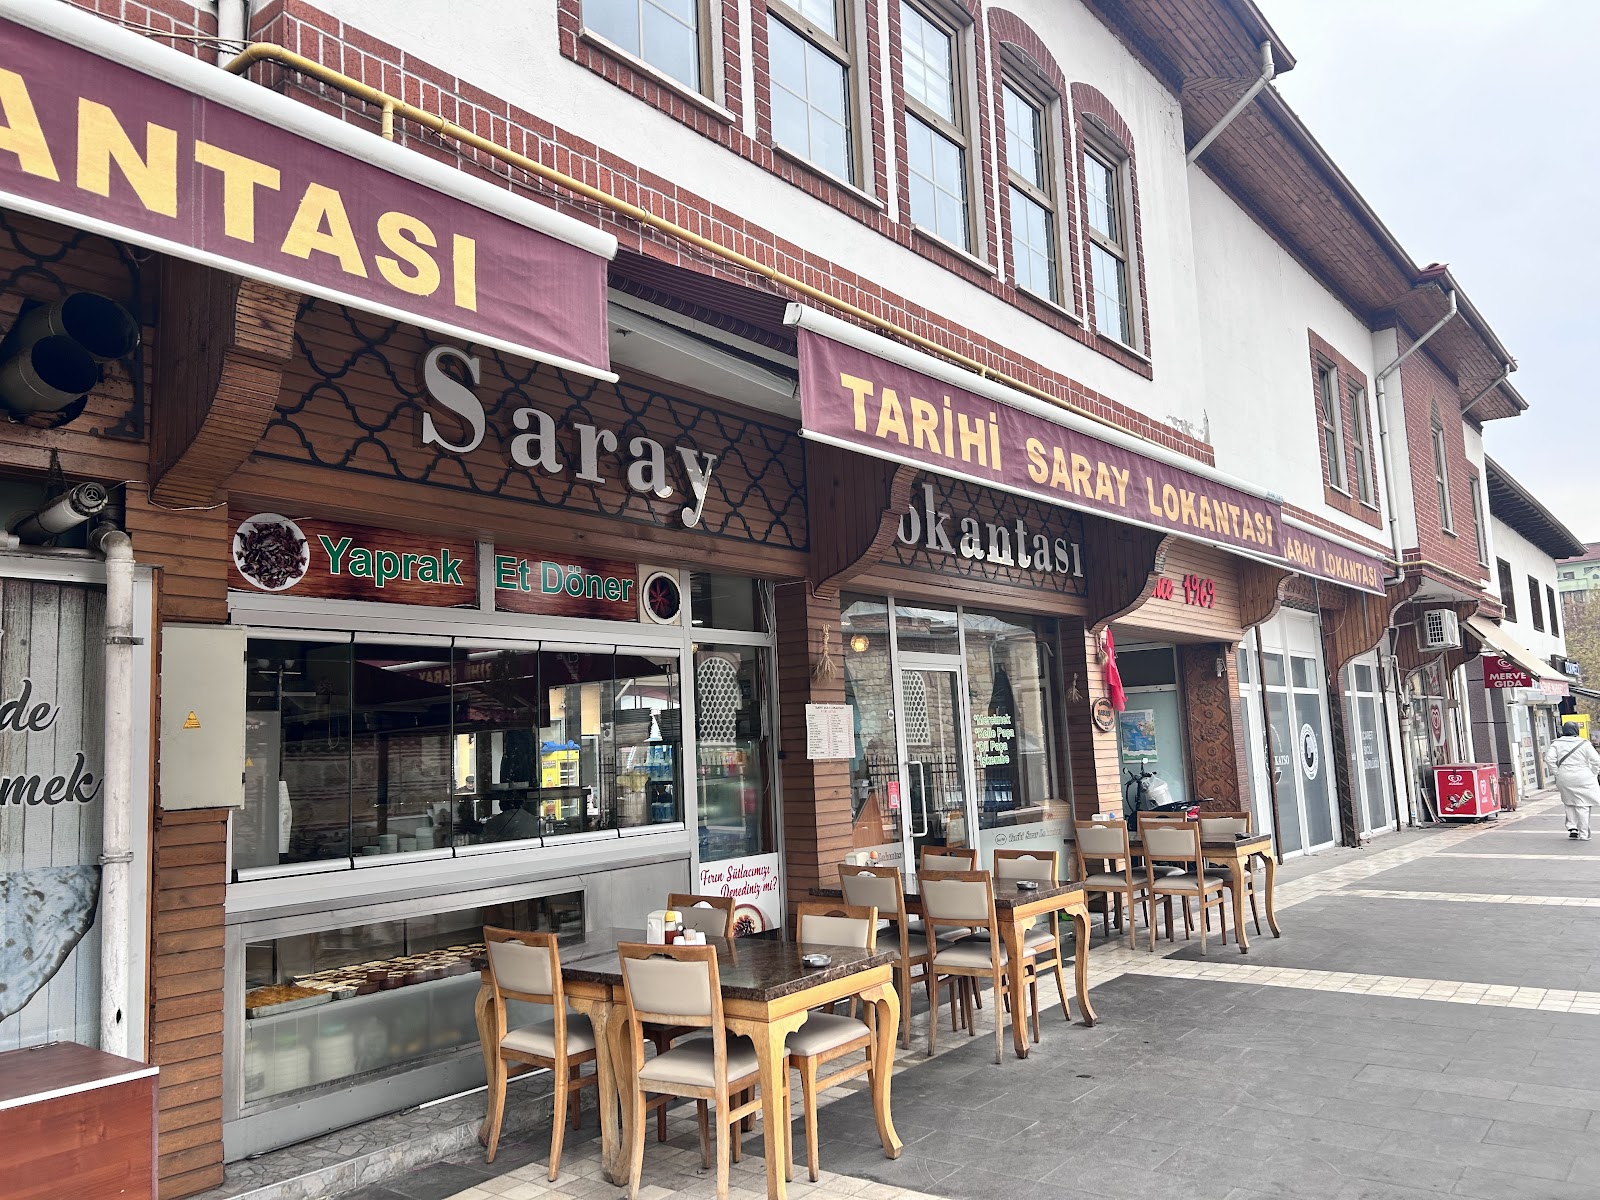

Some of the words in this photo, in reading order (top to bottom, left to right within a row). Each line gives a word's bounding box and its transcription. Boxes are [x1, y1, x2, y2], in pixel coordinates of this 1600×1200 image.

[422, 346, 717, 527] Saray
[840, 373, 1001, 471] TARİHİ
[1026, 437, 1129, 508] SARAY
[1147, 476, 1273, 548] LOKANTASI
[318, 535, 463, 588] Yaprak
[494, 554, 532, 592] Et
[540, 561, 634, 602] Döner
[1284, 536, 1316, 569] ARAY
[1322, 550, 1377, 588] LOKANTASI
[1183, 574, 1216, 609] 1969
[1489, 672, 1527, 681] MERVE
[720, 881, 762, 899] Denediniz
[763, 876, 778, 892] mi?
